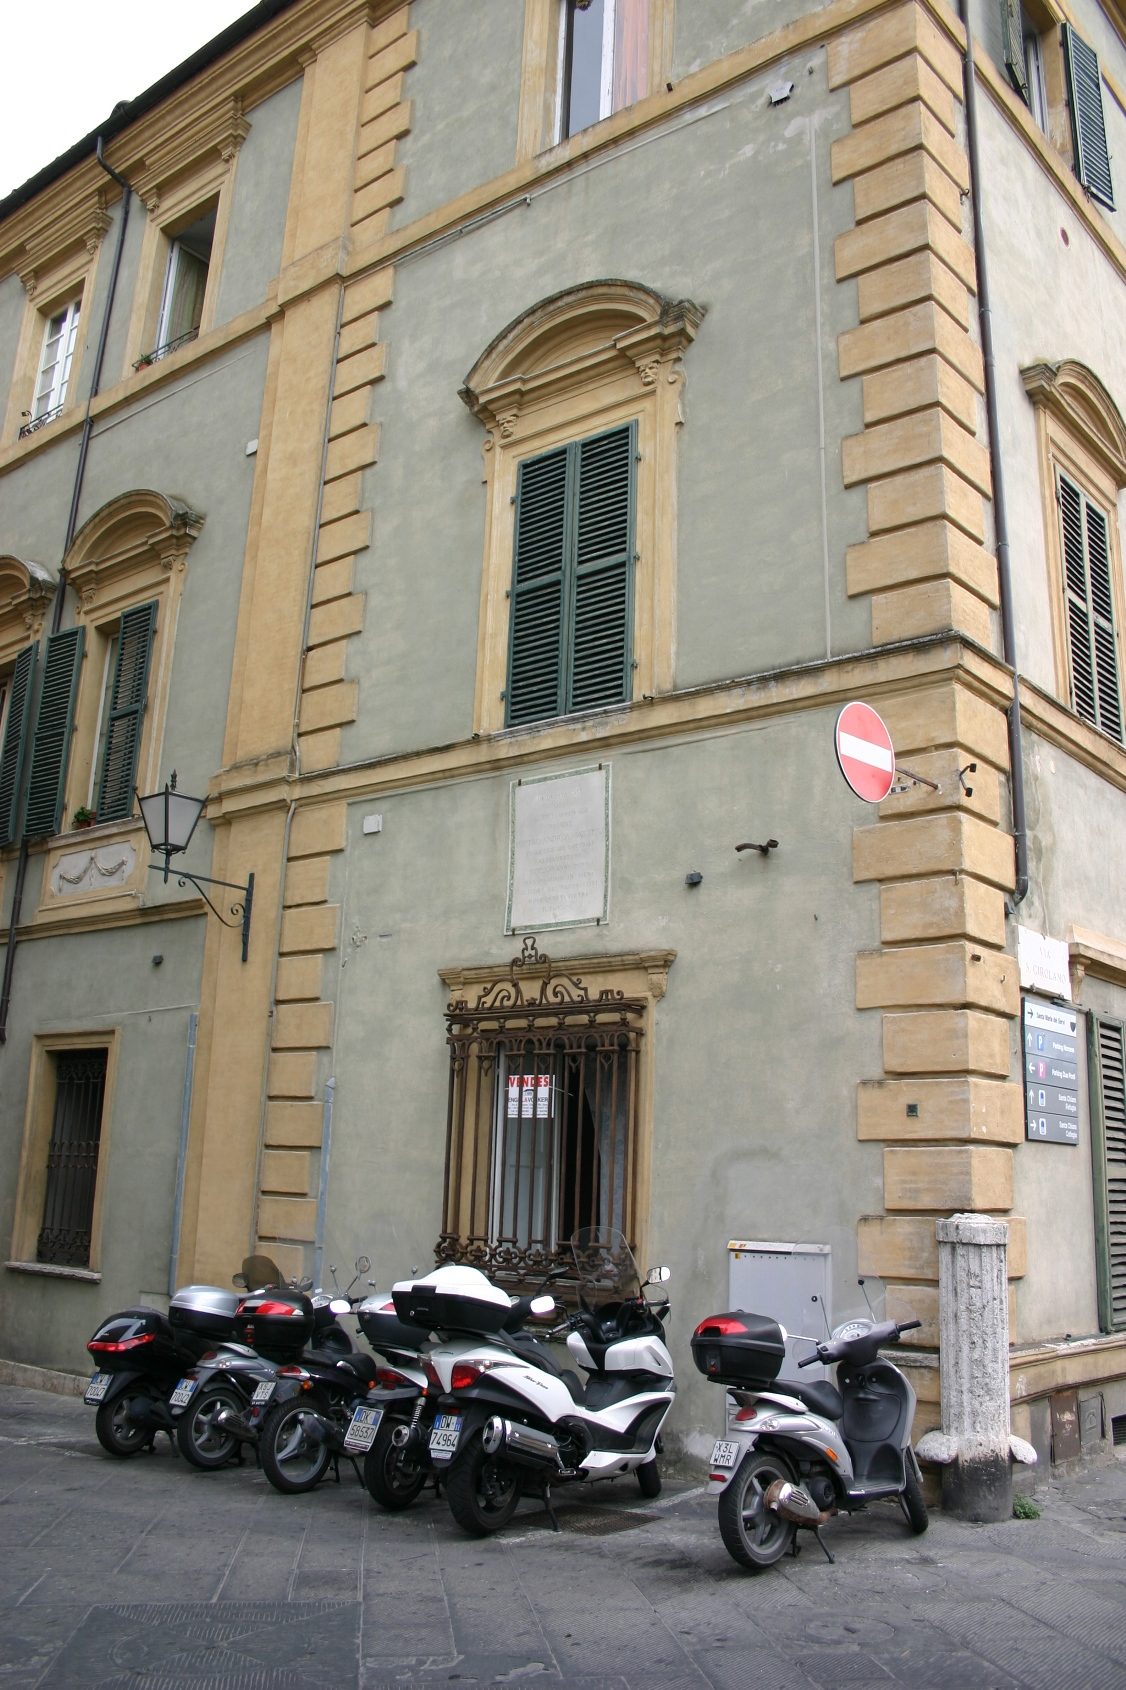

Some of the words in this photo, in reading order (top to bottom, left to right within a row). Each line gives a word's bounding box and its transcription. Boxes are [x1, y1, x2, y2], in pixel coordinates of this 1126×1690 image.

[441, 1415, 453, 1429] DW
[350, 1424, 375, 1439] 58537
[431, 1432, 458, 1447] 74964
[716, 1443, 733, 1454] X3L
[713, 1454, 731, 1465] WMR
